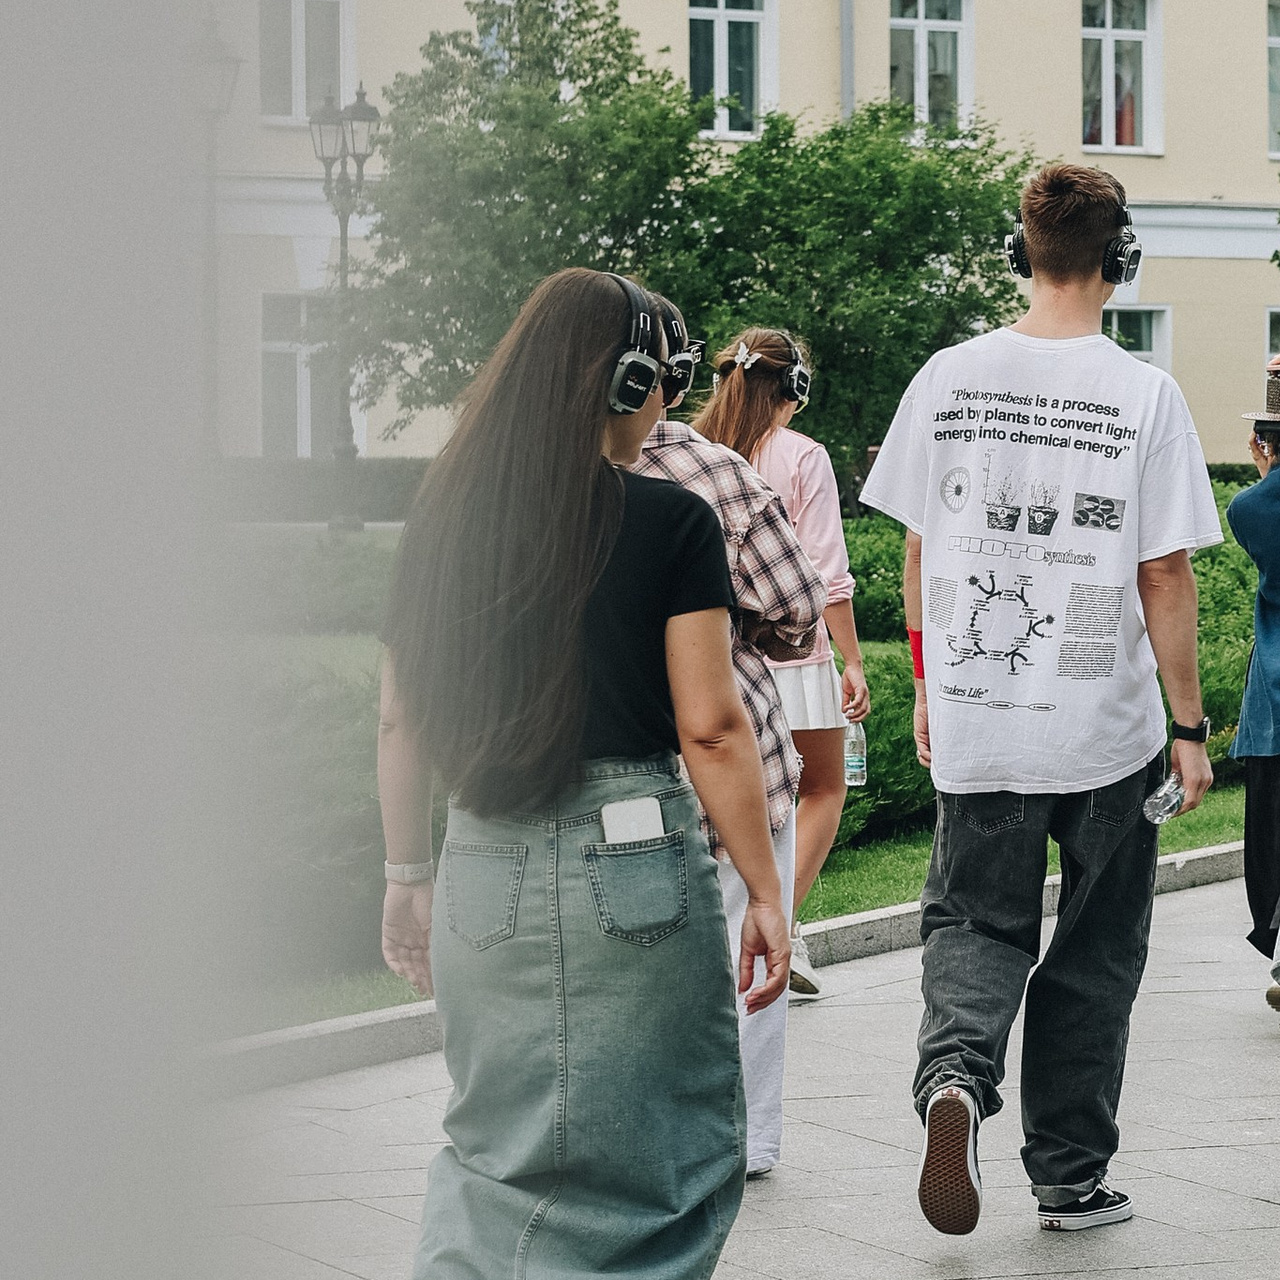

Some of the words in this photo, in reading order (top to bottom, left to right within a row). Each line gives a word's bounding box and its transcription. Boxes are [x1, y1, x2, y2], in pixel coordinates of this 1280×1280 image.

[1035, 394, 1048, 408] is
[1050, 398, 1060, 409] a
[1061, 399, 1120, 418] process
[933, 407, 964, 422] used
[967, 406, 981, 423] by
[984, 407, 1030, 425] plants
[1033, 413, 1047, 427] to
[1050, 417, 1104, 434] convert
[1105, 422, 1138, 441] light
[934, 428, 977, 443] energy
[979, 425, 1007, 440] into
[1009, 430, 1072, 449] chemical
[999, 508, 1006, 516] A
[1036, 514, 1043, 522] B
